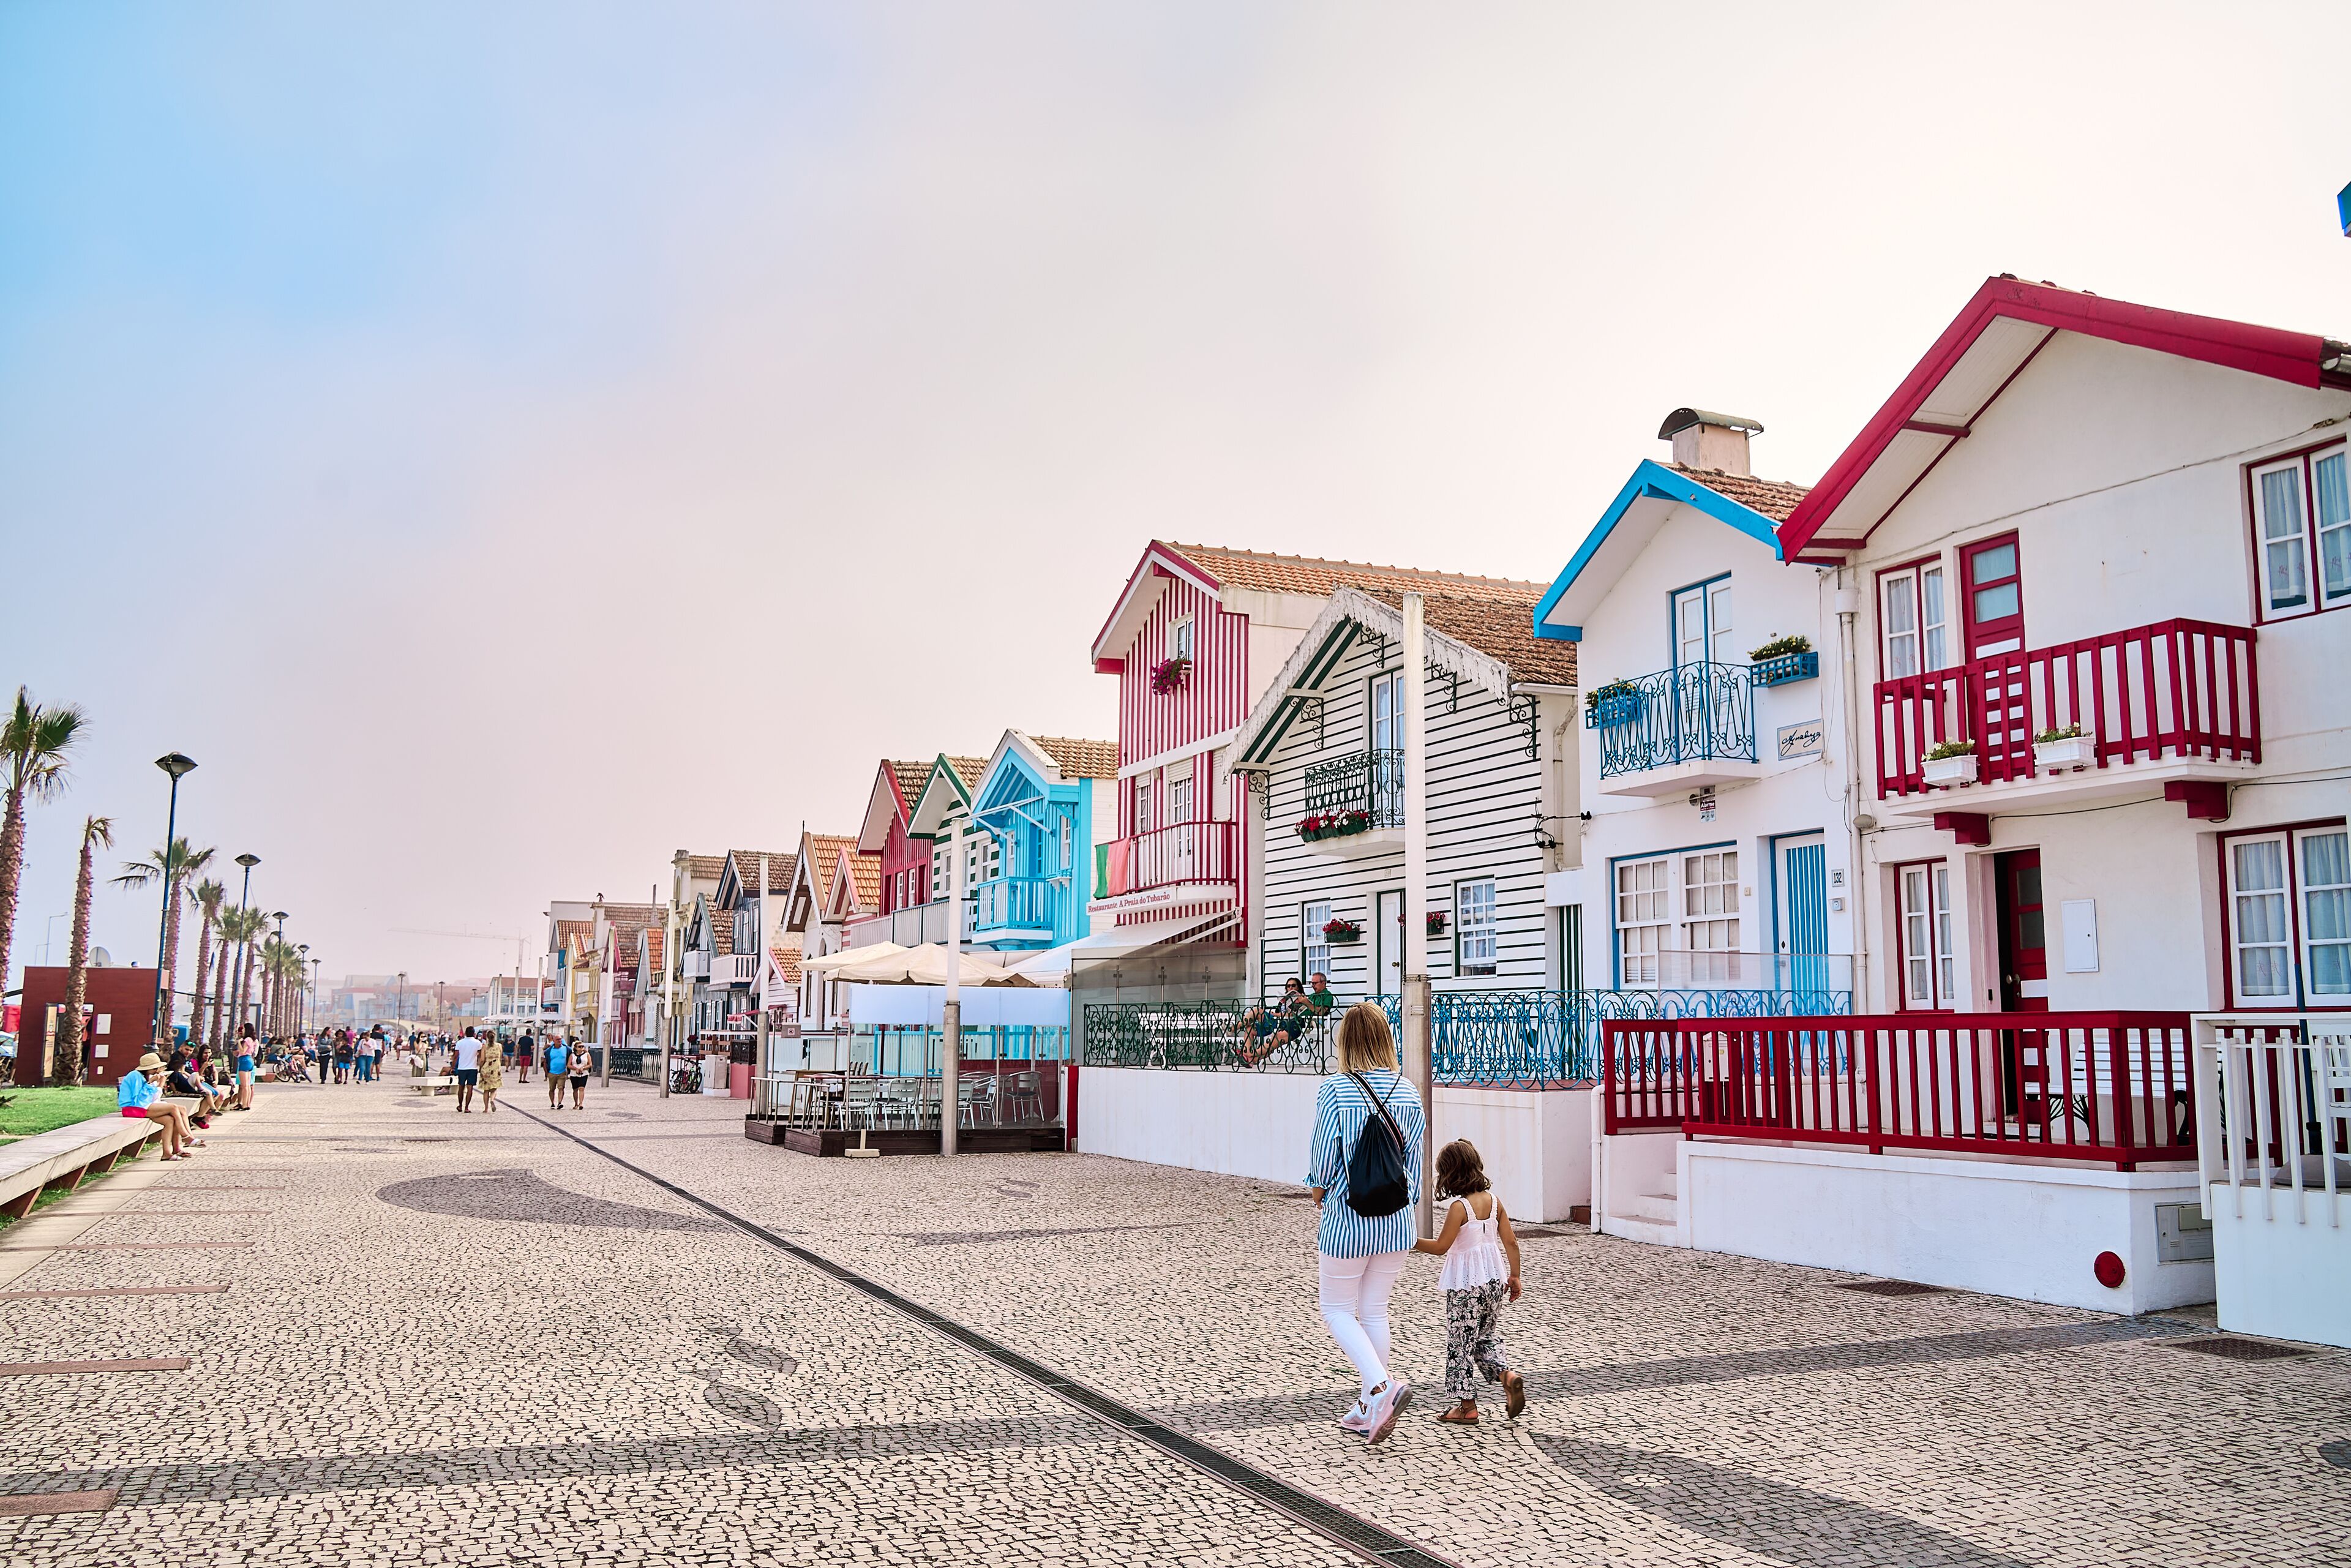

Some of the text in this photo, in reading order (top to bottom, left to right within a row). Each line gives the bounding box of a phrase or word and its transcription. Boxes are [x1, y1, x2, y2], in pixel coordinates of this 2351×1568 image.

[1834, 872, 1842, 883] 132
[1088, 902, 1117, 913] Restaurante
[1124, 898, 1139, 906] Praia
[1147, 892, 1170, 902] Tubarão
